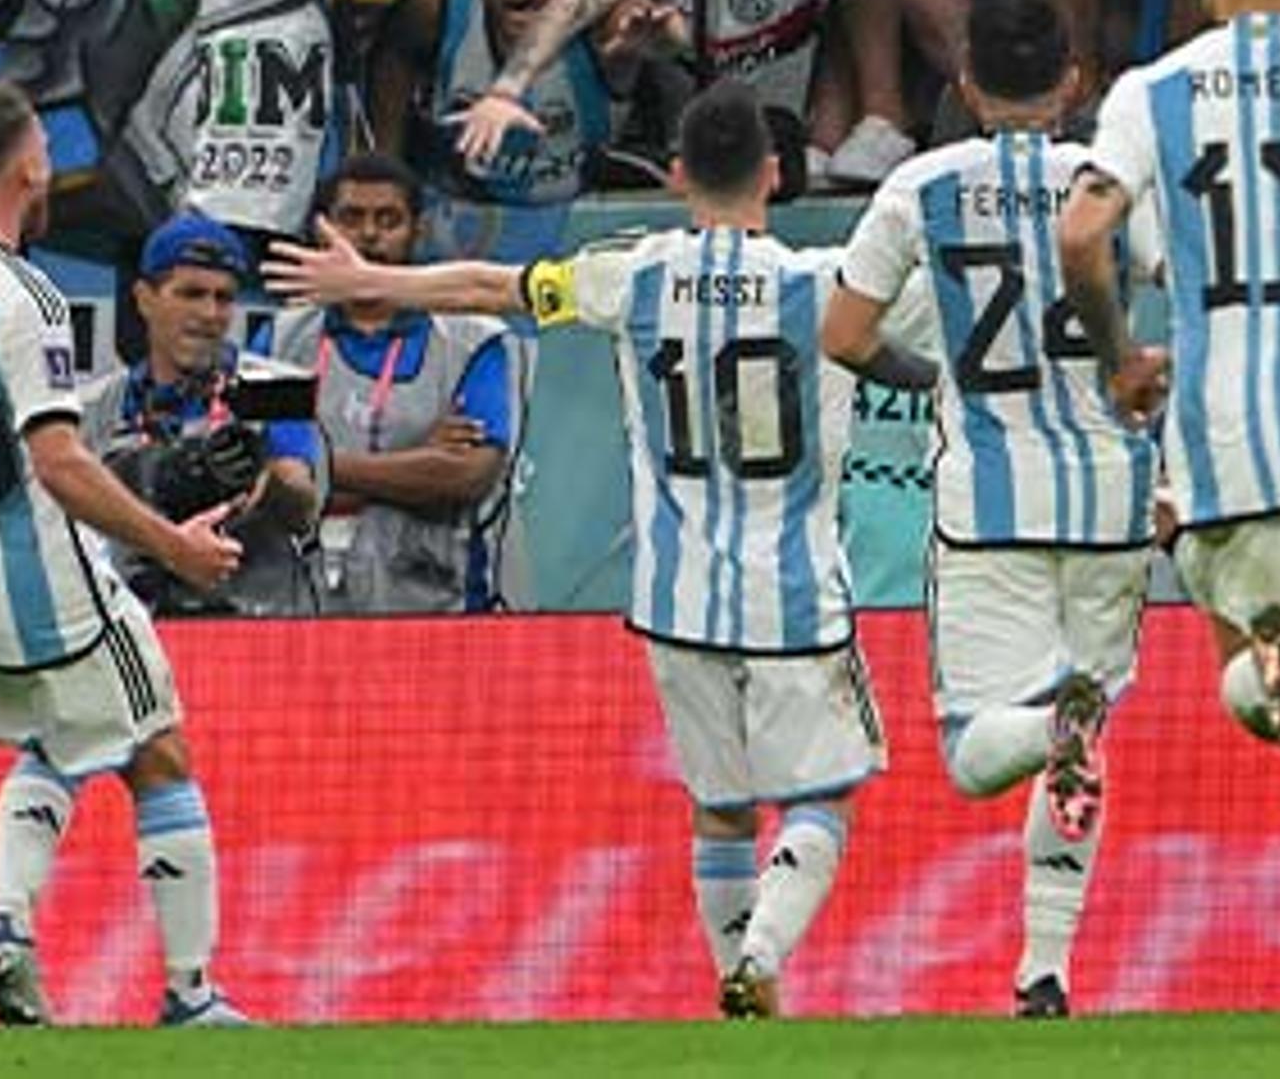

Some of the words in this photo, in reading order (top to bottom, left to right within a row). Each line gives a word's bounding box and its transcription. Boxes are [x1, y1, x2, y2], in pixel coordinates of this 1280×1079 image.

[194, 143, 294, 192] 2022
[672, 274, 768, 307] MESSI
[648, 338, 803, 478] 10
